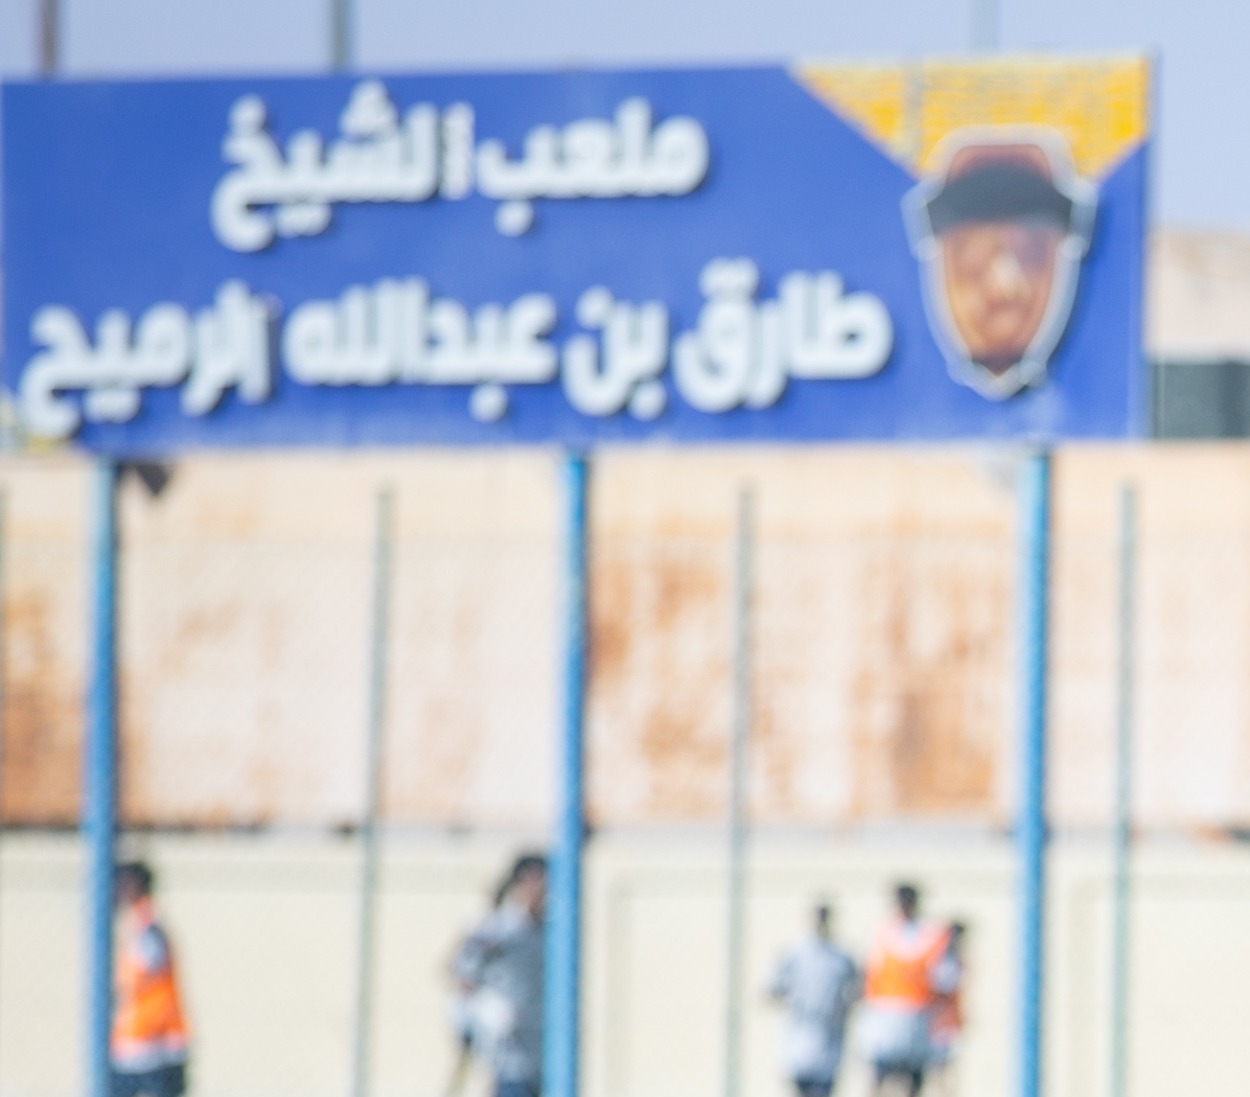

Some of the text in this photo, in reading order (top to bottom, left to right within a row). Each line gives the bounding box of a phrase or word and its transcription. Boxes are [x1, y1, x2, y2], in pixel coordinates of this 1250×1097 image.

[210, 76, 708, 254] ملعب الشيخ
[19, 256, 893, 439] طارق بن عبدالله الرميح
